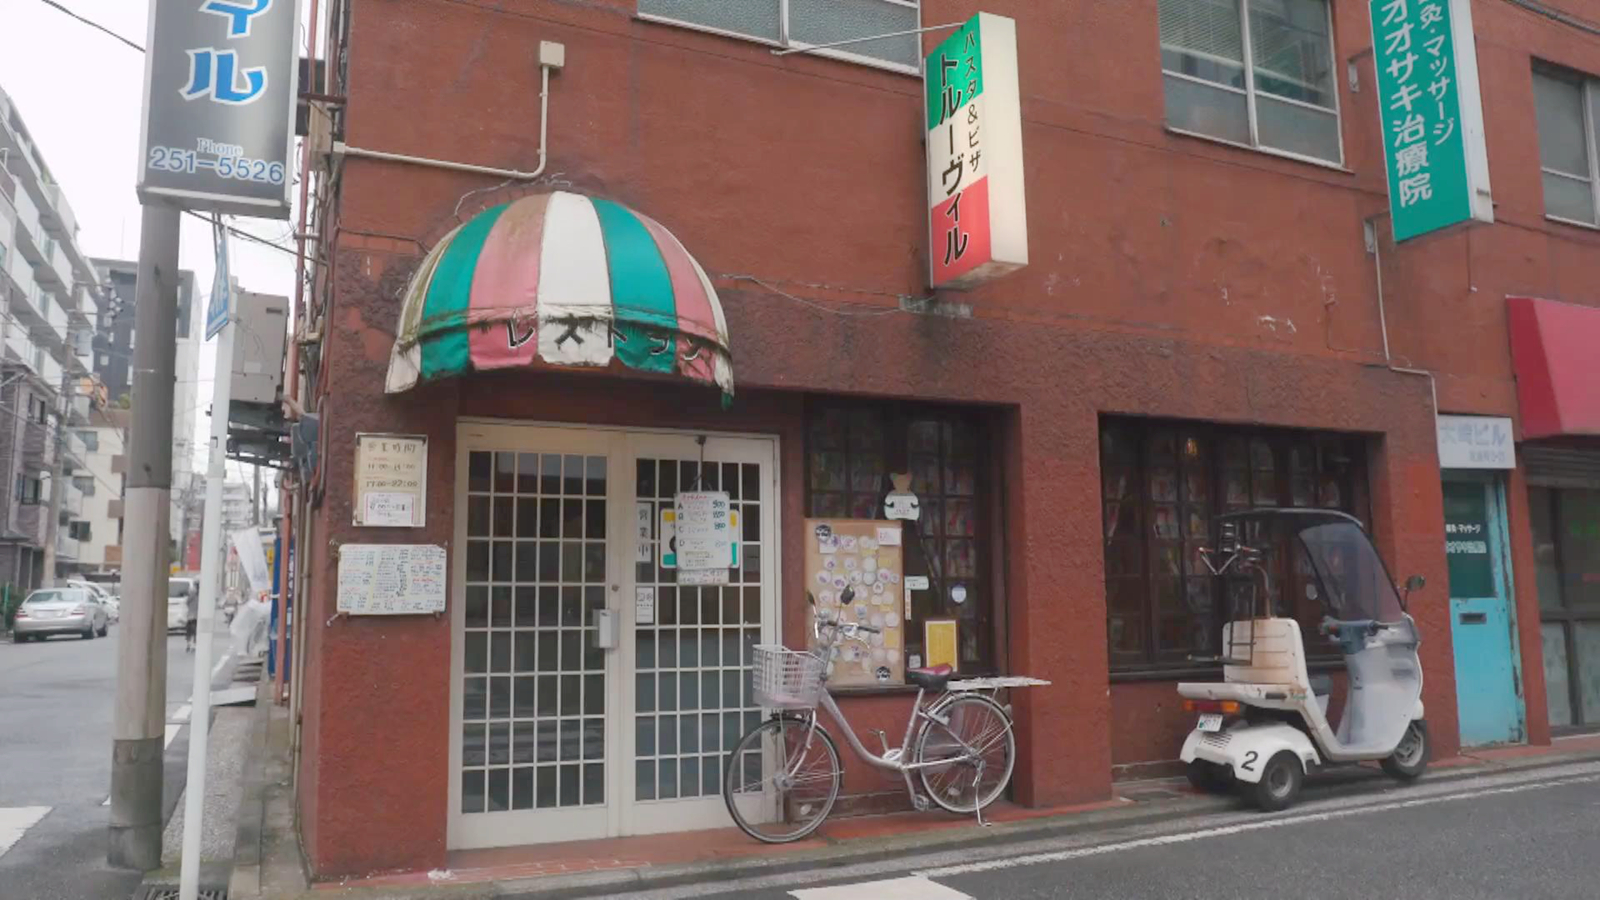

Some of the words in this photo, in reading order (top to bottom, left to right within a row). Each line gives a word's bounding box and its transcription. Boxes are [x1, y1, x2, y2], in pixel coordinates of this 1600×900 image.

[1381, 0, 1433, 208] オオサキ治療院
[1417, 0, 1455, 146] 灸・マッサージ
[149, 146, 285, 185] 251-5526
[197, 137, 244, 156] Phone
[938, 52, 969, 267] トルーヴィル
[1241, 750, 1259, 771] 2
